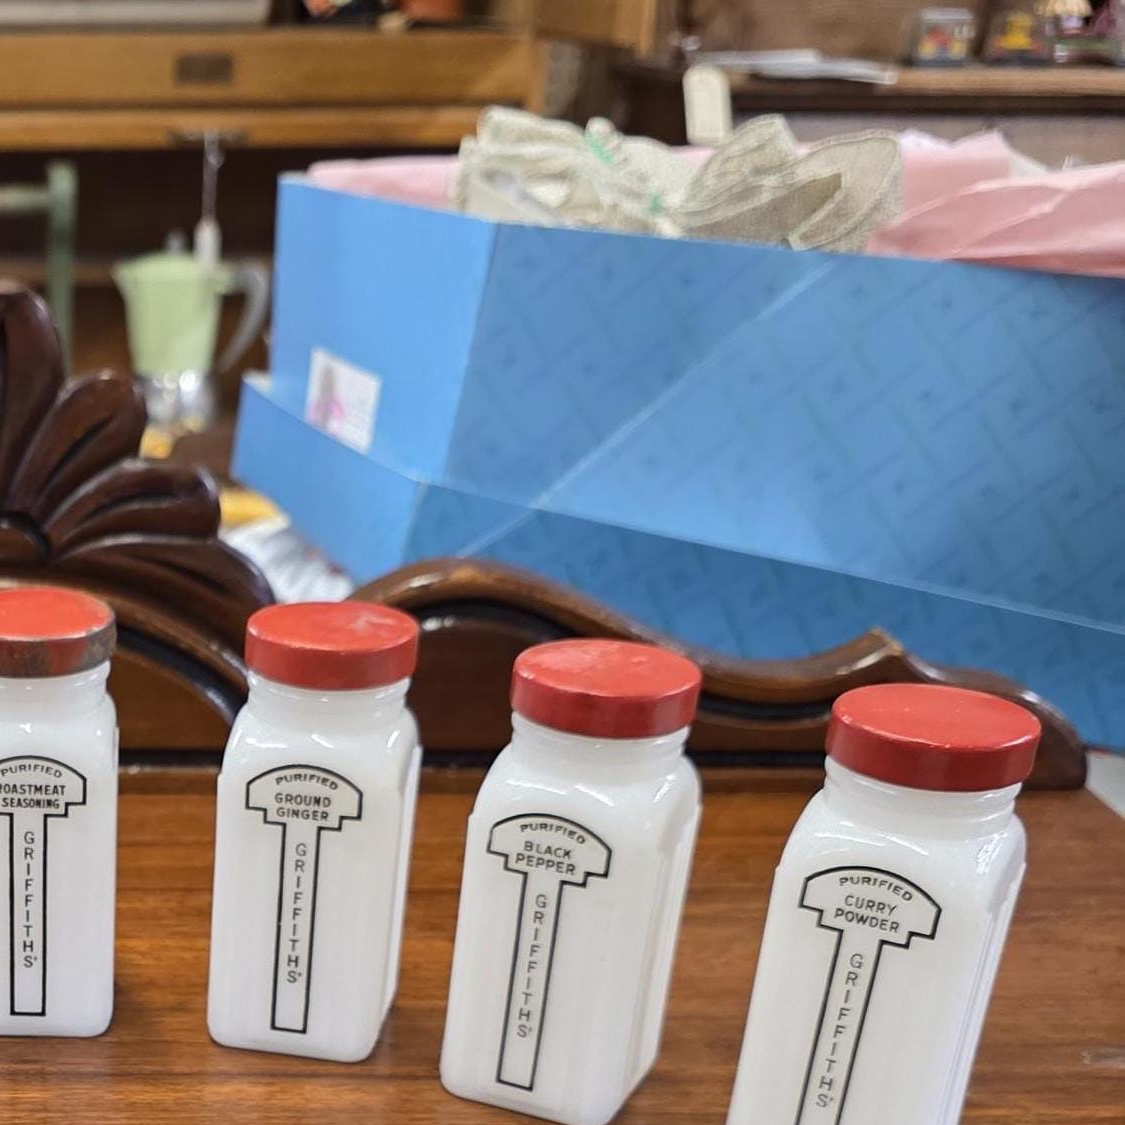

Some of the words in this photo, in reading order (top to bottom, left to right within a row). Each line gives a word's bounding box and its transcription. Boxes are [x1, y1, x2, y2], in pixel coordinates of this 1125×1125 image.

[0, 764, 63, 779] PURIFIED
[274, 773, 339, 791] PURIFIED
[1, 797, 61, 810] SEASONING
[274, 792, 332, 808] GROUND
[276, 807, 330, 822] GINGER
[519, 822, 586, 845] PURIFIED
[523, 840, 572, 860] BLACK
[514, 852, 576, 876] PEPPER
[838, 876, 913, 902] PURIFIED
[844, 894, 898, 916] CURRY
[834, 908, 900, 933] POWDER
